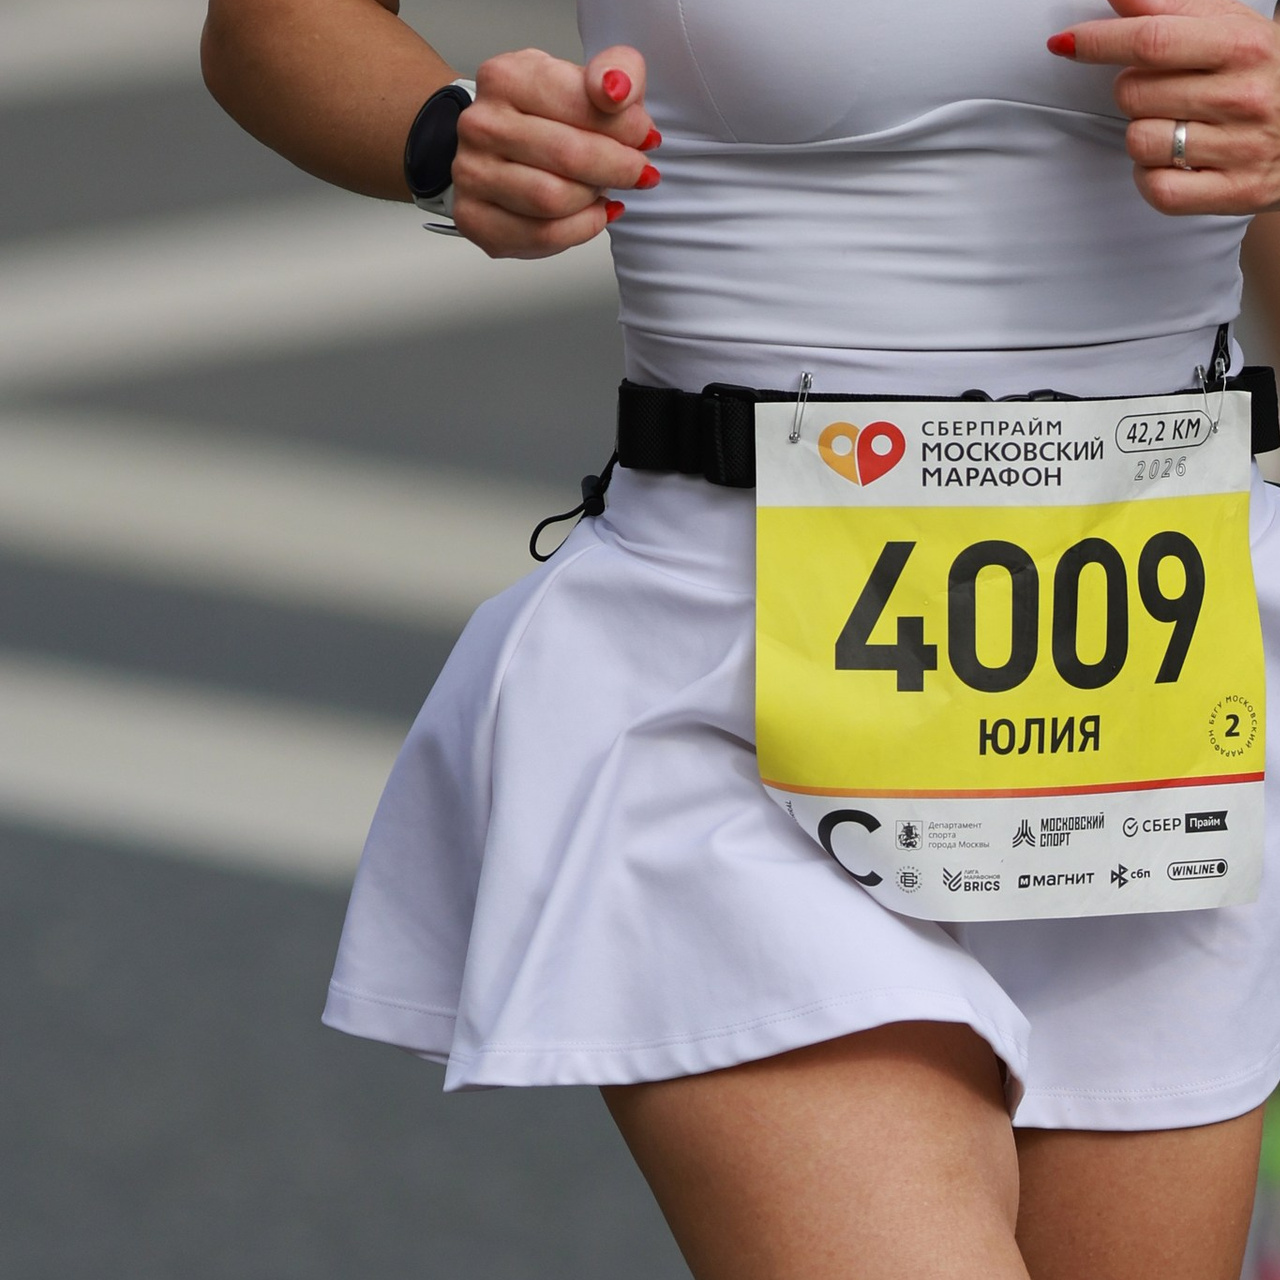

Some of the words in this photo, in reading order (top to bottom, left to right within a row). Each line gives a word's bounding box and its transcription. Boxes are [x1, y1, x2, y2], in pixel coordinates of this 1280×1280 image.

[921, 417, 1062, 436] СБЕРПРАЙМ
[1126, 420, 1165, 446] 42,2
[921, 436, 1104, 462] МОСКОВСКИЙ
[921, 467, 1062, 487] МАРАФОН
[1134, 456, 1187, 481] 2026
[834, 530, 1206, 694] 4009
[1225, 713, 1240, 738] 2
[978, 715, 1102, 756] ЮЛИЯ
[928, 821, 982, 830] Департамент
[1040, 811, 1105, 832] МОСКОВСКИЙ
[1142, 817, 1182, 833] СБЕР
[1189, 816, 1220, 829] Прайм
[928, 832, 957, 840] спорта
[928, 841, 957, 850] города
[958, 841, 990, 849] Москвы
[1040, 832, 1071, 847] СПОРТ
[1130, 868, 1151, 879] сбп
[1172, 863, 1216, 877] WINLINE
[963, 880, 1001, 892] BRICS
